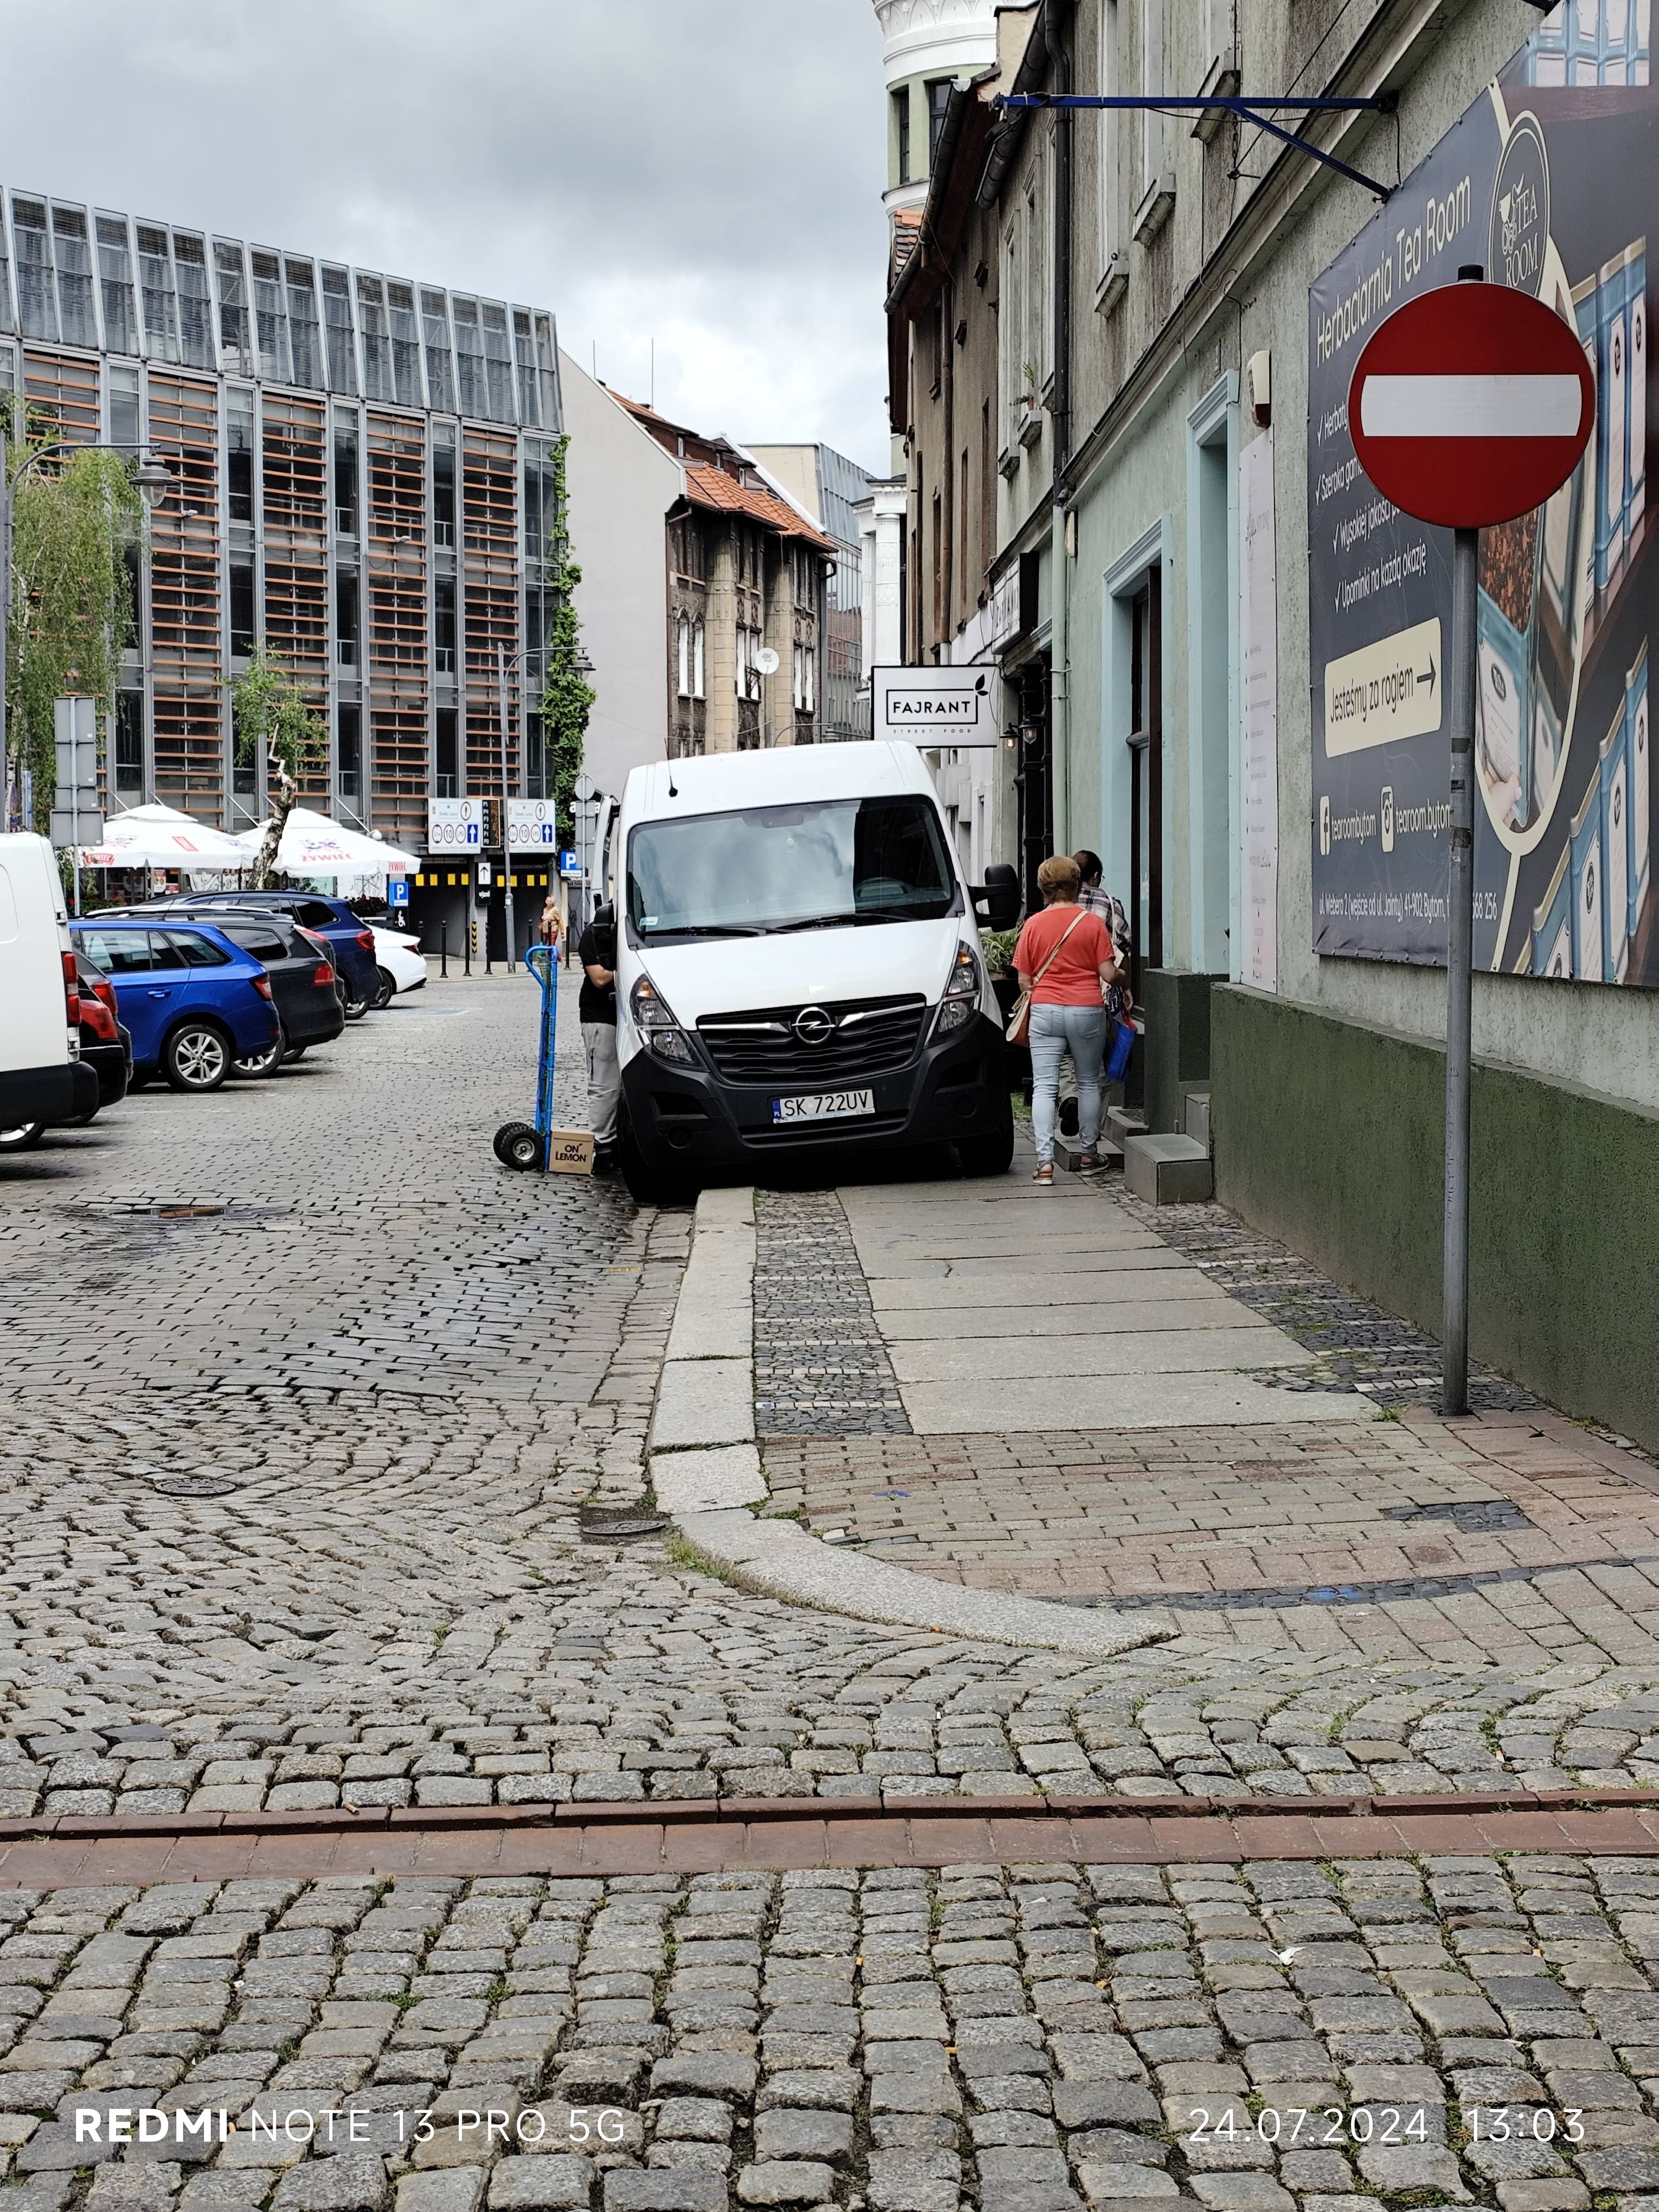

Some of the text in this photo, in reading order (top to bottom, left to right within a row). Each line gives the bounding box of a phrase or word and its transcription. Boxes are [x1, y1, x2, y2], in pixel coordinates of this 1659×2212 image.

[1516, 183, 1539, 234] TEA
[1316, 175, 1471, 368] Herbaciarnia Tea Room
[1505, 232, 1539, 287] ROOM
[1324, 401, 1348, 440] Herbaty
[1321, 461, 1345, 501] Szeroka
[1340, 505, 1366, 552] Wysokiej
[1342, 537, 1427, 614] Upominki na każdą okazję
[893, 701, 970, 713] FAJRANT
[1330, 663, 1414, 723] Jesteśmy za rogiem
[1331, 808, 1377, 845] tearoombytom
[1325, 893, 1343, 916] Webera
[1344, 893, 1348, 916] 2
[1348, 892, 1368, 922] (wejście
[1368, 892, 1376, 916] od
[1404, 892, 1423, 917] 41-902
[1424, 892, 1446, 924] Bytom,
[1484, 892, 1497, 921] 256
[784, 1098, 807, 1116] SK
[813, 1091, 868, 1114] 722UV
[555, 1151, 587, 1162] LEMON
[564, 1144, 579, 1153] ON
